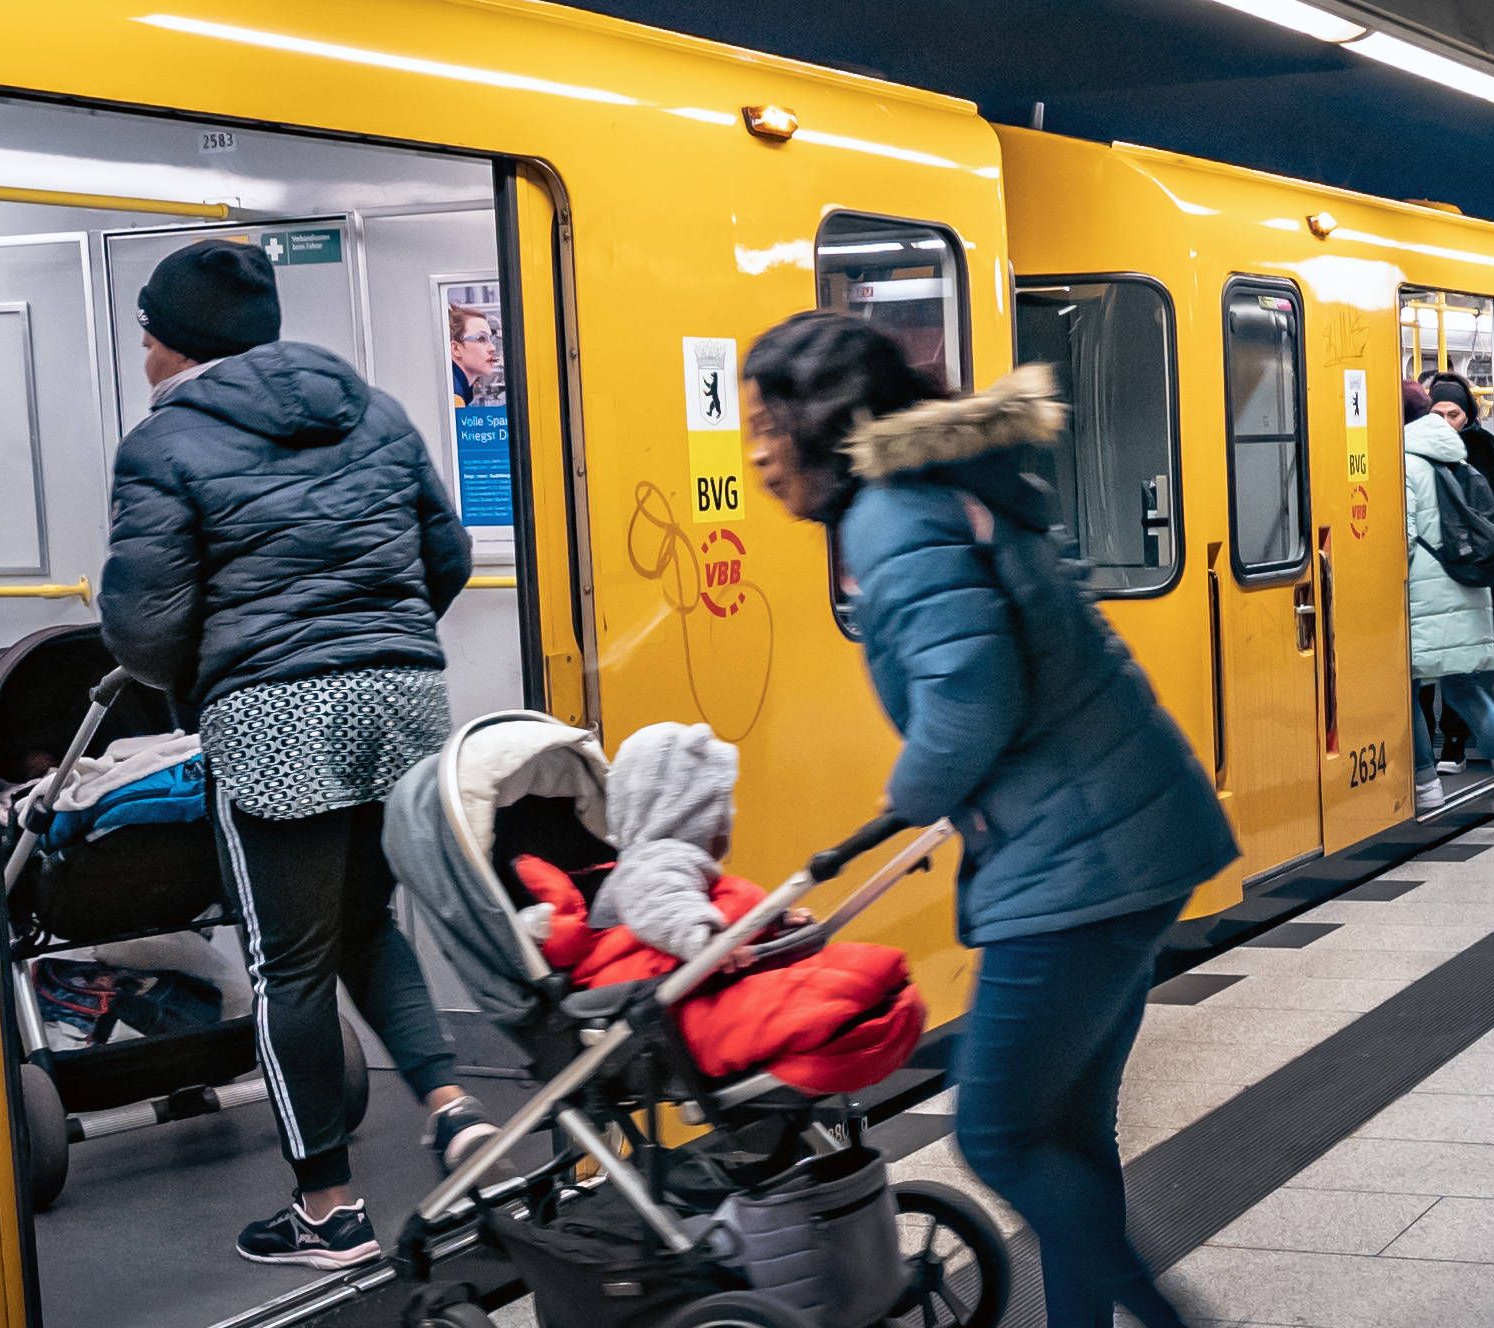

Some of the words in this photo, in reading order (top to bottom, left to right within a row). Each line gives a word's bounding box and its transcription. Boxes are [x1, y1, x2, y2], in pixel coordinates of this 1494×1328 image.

[202, 133, 235, 149] 2583
[1349, 454, 1367, 476] BVG
[697, 476, 738, 511] BVG
[705, 559, 742, 588] VBB
[1349, 741, 1387, 788] 2634
